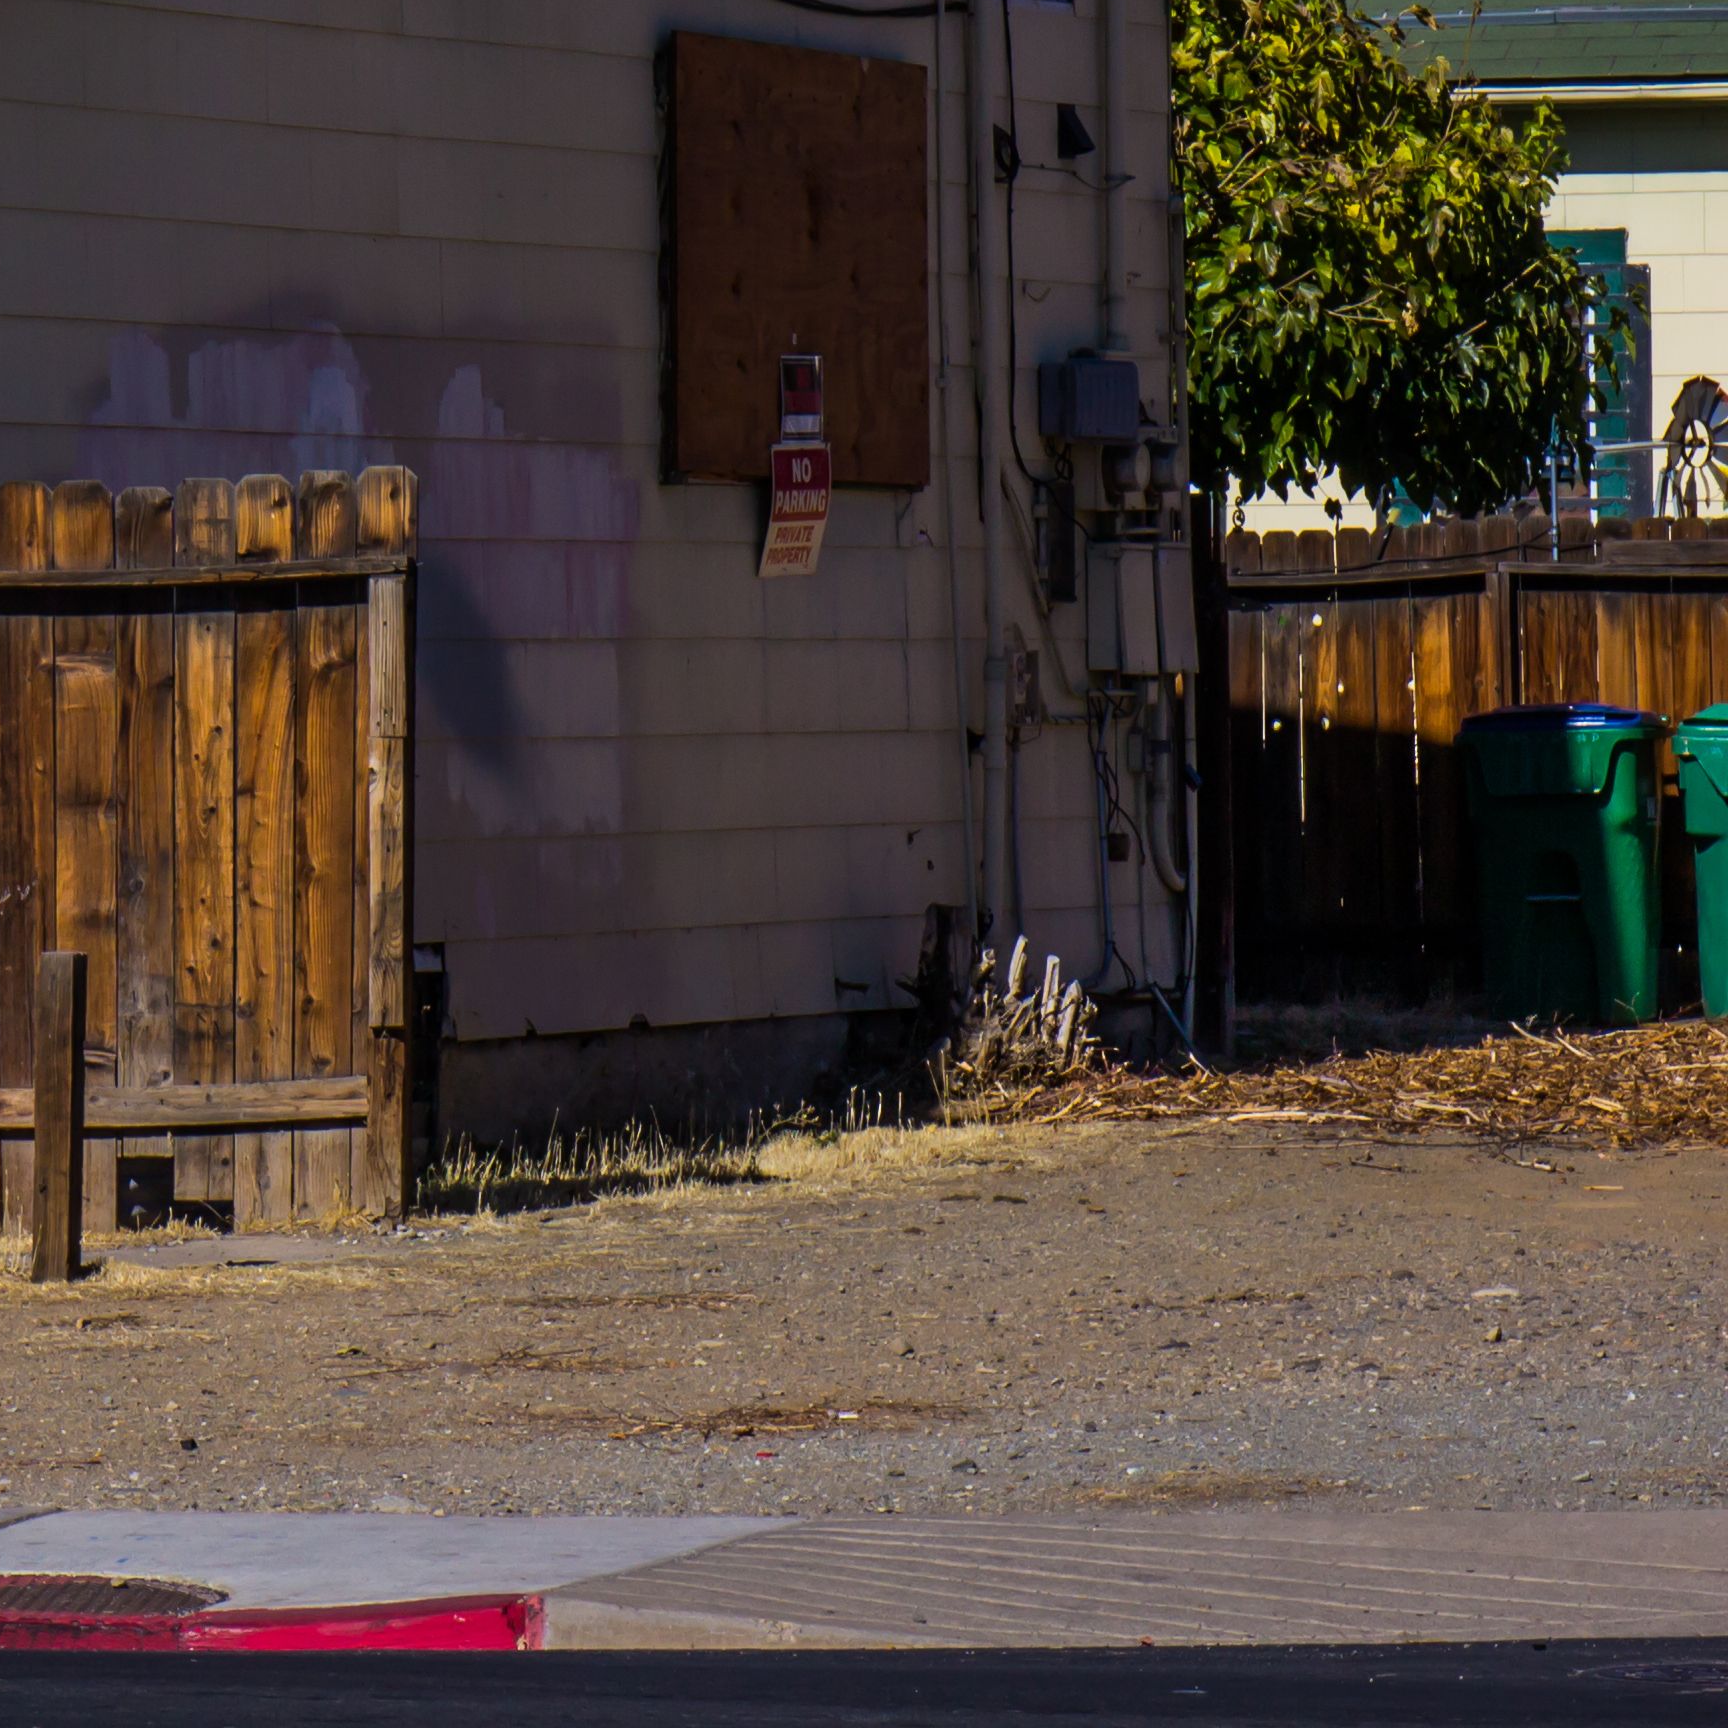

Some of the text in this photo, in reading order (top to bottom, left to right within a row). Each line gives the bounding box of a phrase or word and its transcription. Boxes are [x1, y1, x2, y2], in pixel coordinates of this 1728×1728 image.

[791, 457, 812, 483] NO
[775, 489, 826, 514] PARKING
[774, 525, 815, 544] PRIVATE
[765, 546, 812, 567] PROPERTY
